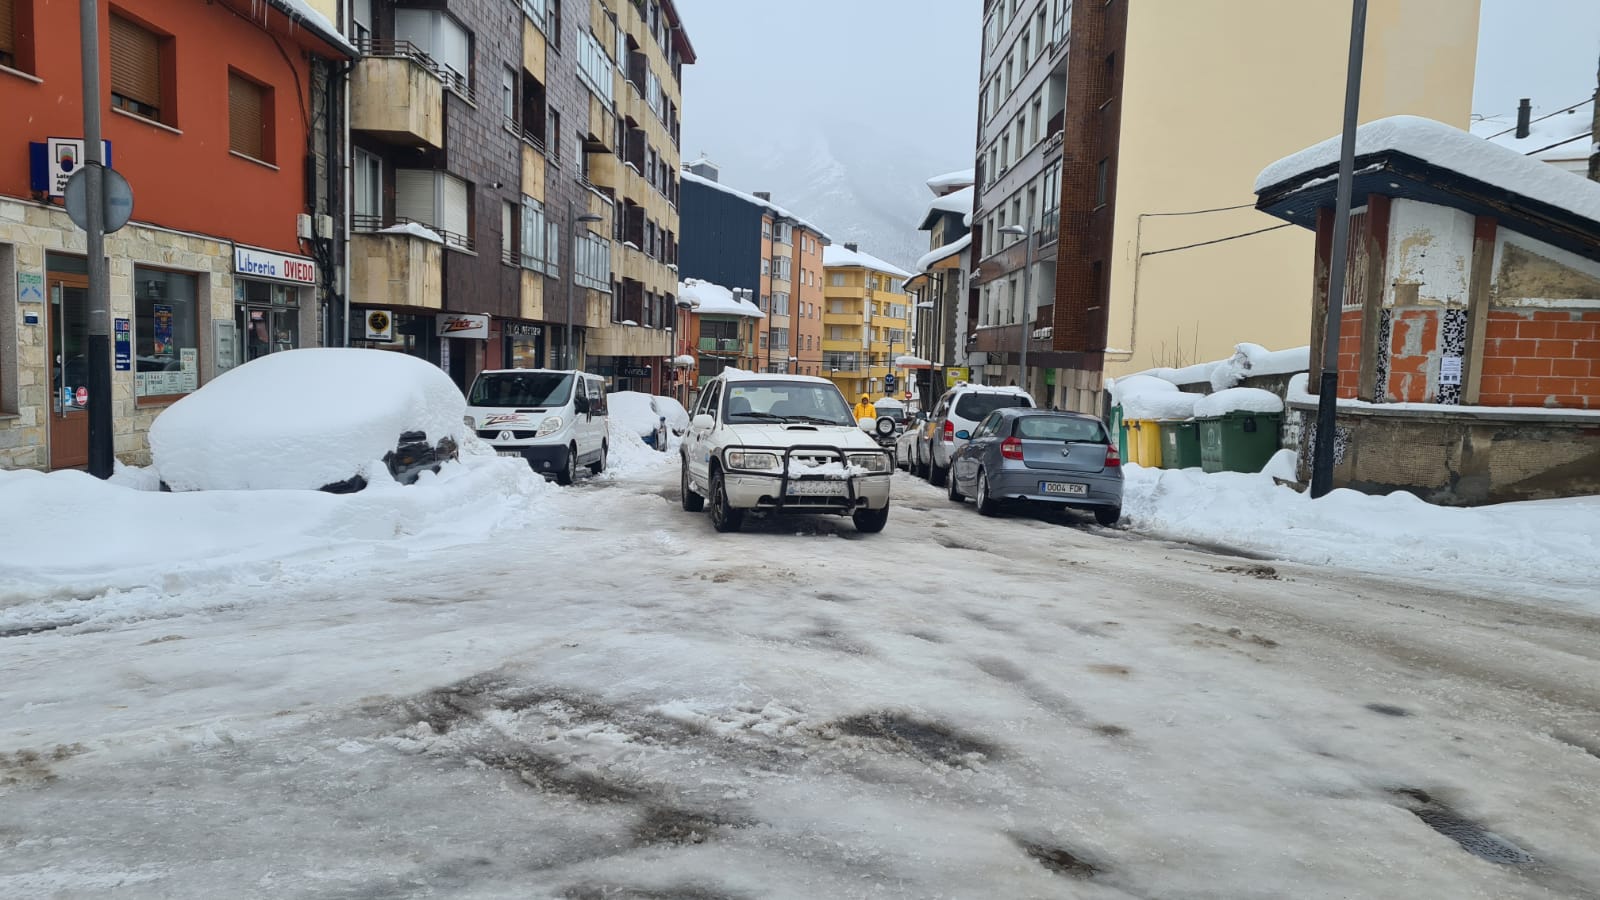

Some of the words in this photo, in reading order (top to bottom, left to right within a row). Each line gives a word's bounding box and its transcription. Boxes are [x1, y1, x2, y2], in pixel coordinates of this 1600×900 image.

[284, 260, 313, 281] OVIEDO
[1047, 483, 1066, 492] 0004
[1069, 484, 1083, 493] FDK
